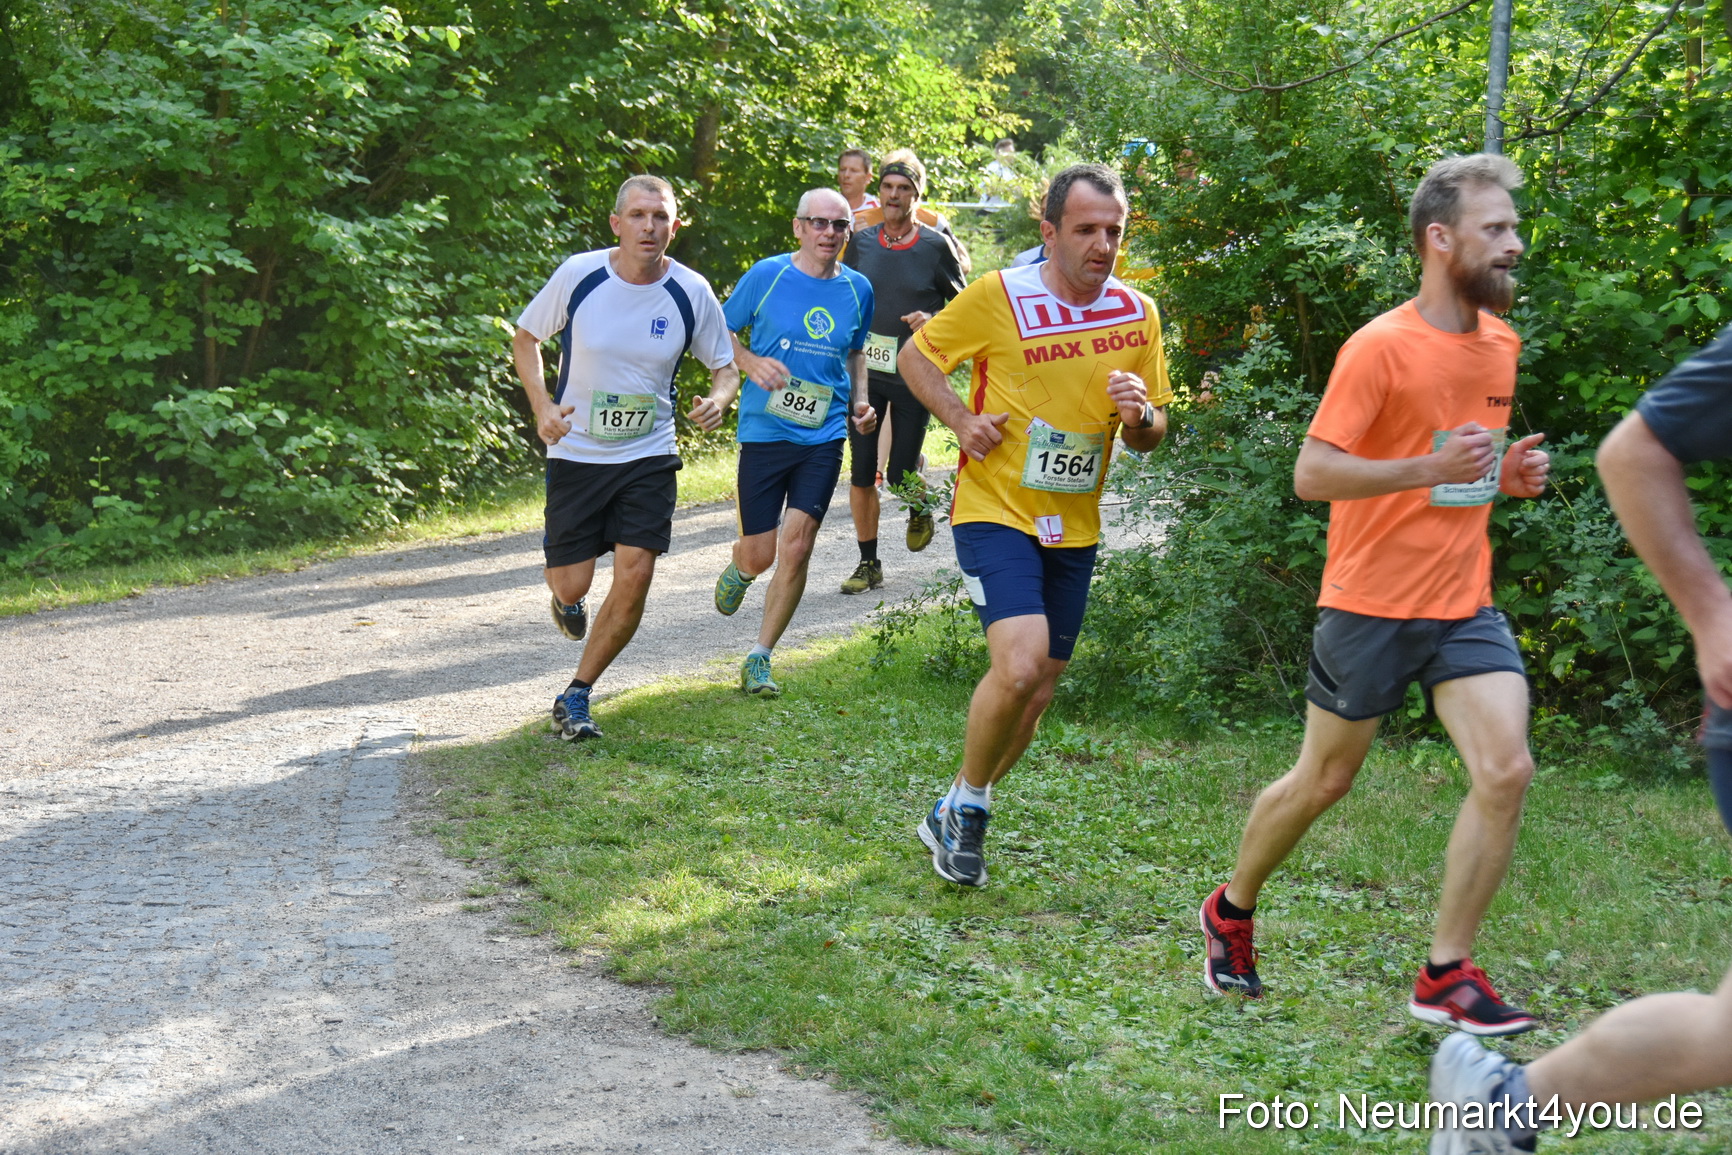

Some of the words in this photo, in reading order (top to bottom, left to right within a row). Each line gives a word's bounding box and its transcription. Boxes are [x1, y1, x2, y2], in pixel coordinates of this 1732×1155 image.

[1023, 341, 1086, 366] MAX
[1091, 330, 1149, 354] BÖGL
[782, 391, 817, 415] 984
[599, 409, 649, 427] 1877
[1038, 451, 1095, 477] 1564
[1043, 474, 1066, 482] Forster
